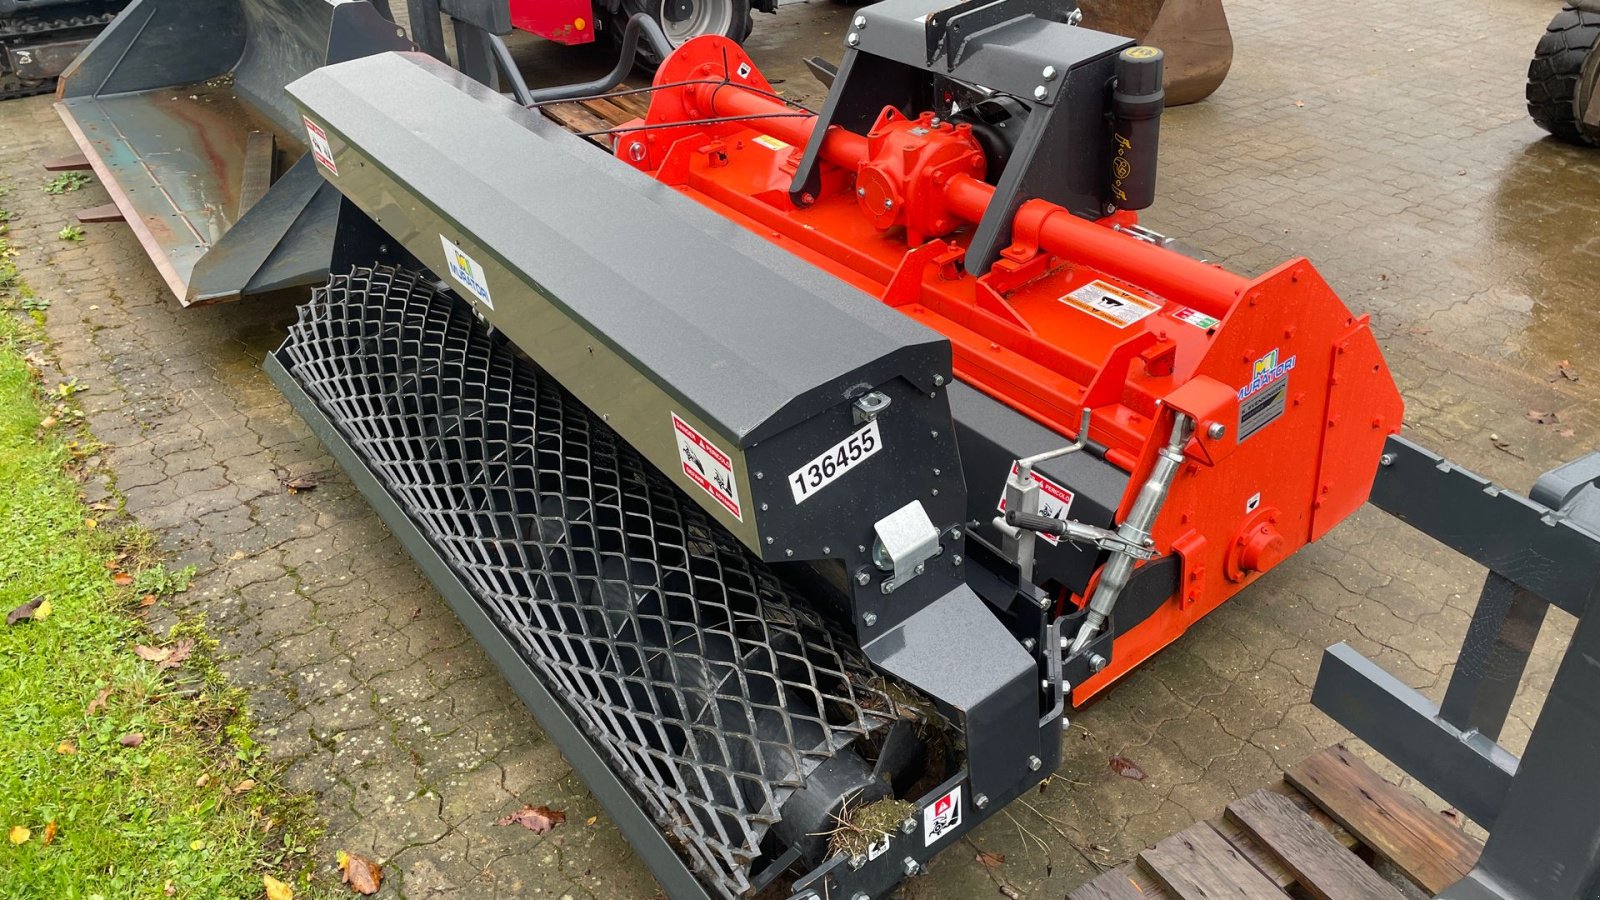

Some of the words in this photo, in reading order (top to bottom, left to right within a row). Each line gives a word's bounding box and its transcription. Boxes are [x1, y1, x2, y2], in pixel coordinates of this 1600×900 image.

[705, 445, 731, 469] PERICOLO
[795, 428, 875, 495] 136455
[1045, 484, 1070, 502] PERICOLO
